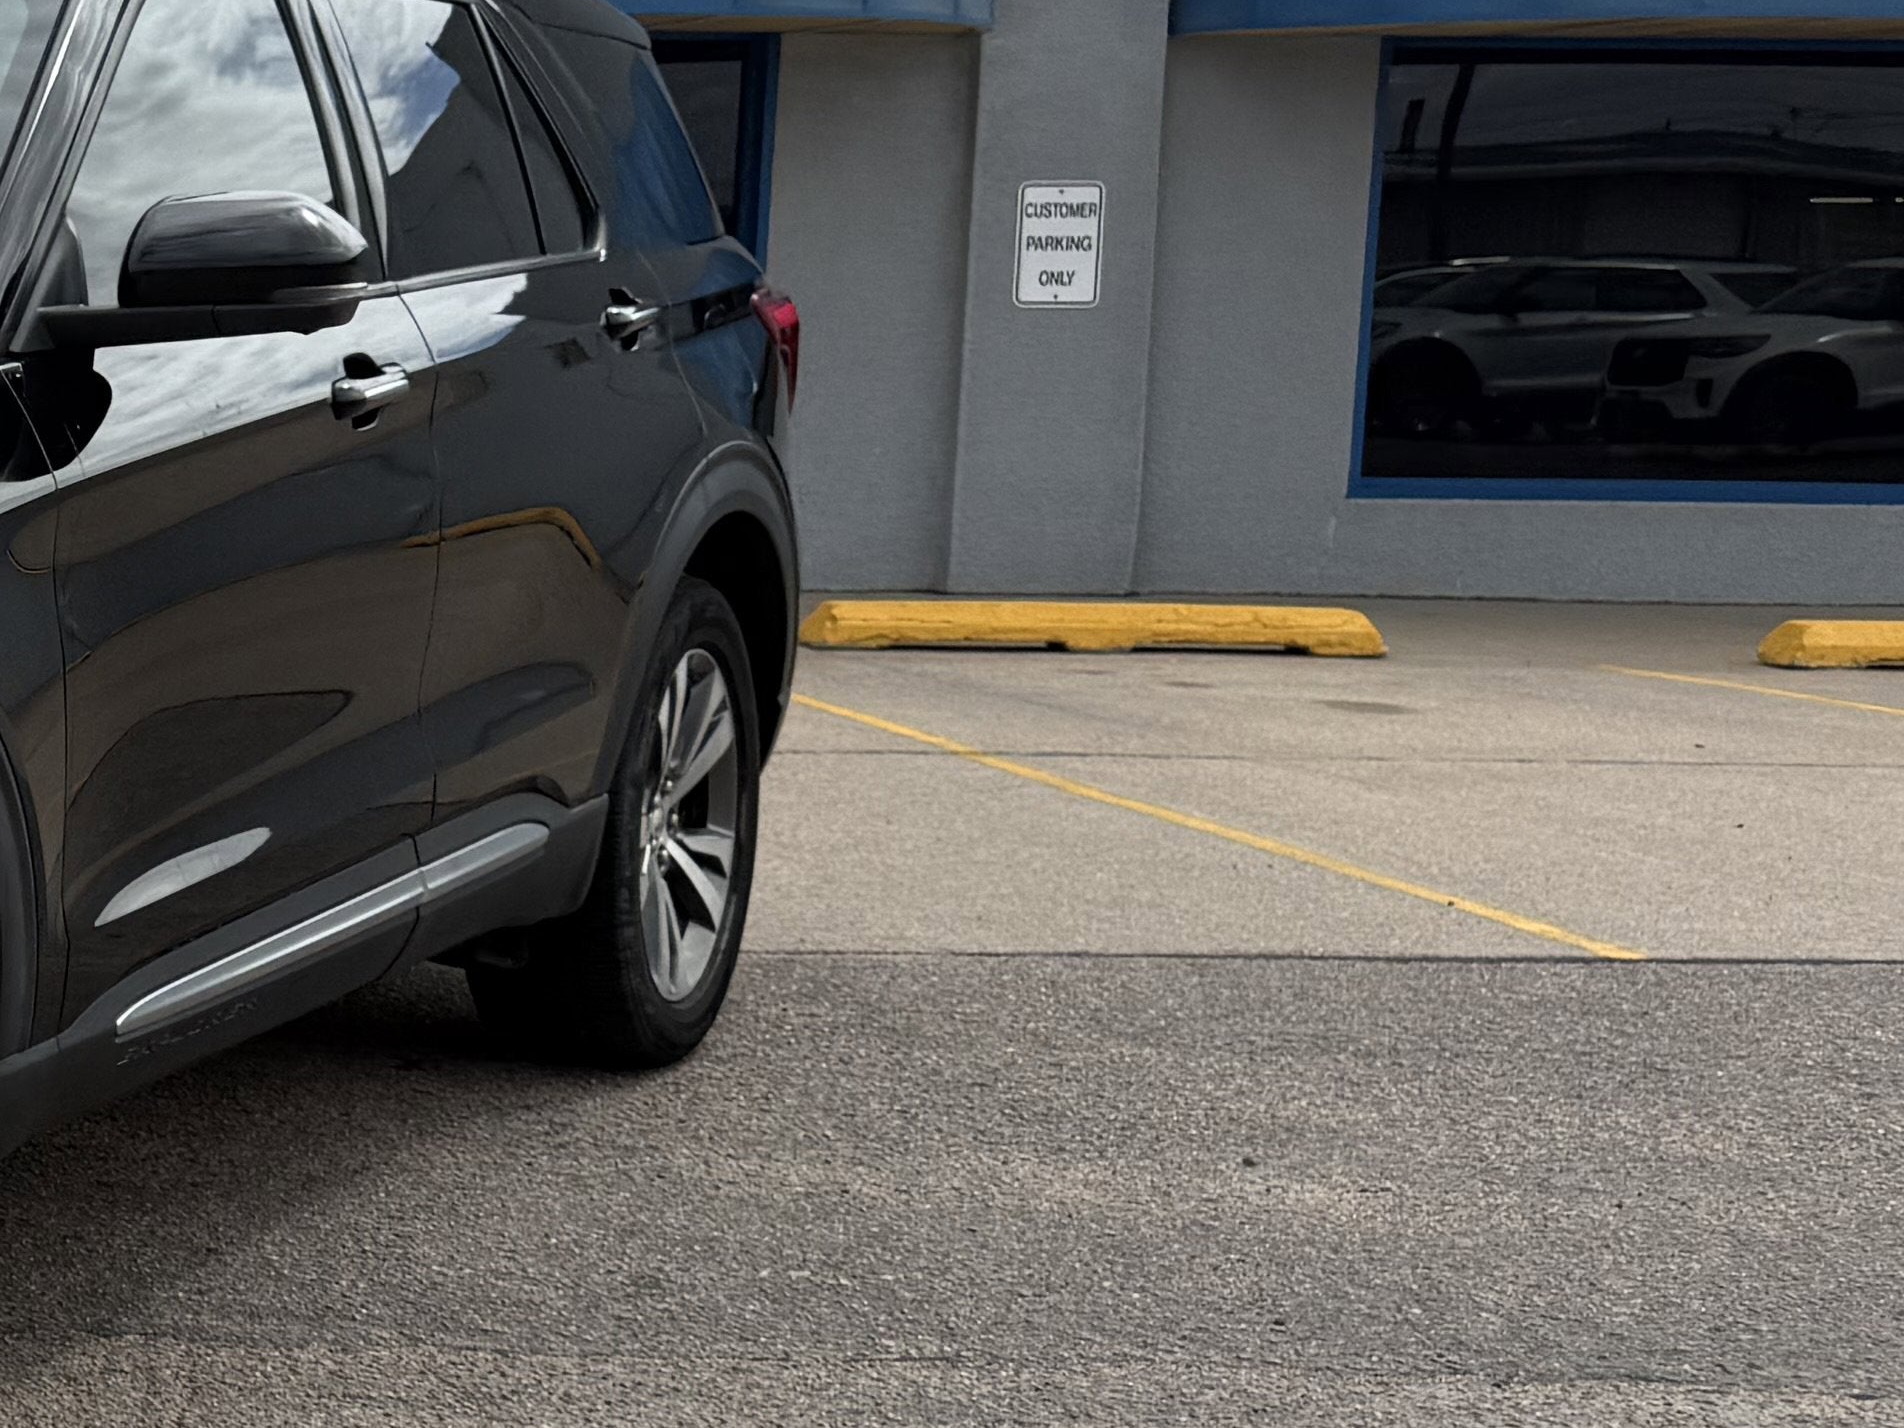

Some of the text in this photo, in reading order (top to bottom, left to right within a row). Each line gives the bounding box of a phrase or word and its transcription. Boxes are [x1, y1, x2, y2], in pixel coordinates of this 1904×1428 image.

[1024, 201, 1098, 219] CUSTOMER
[1026, 235, 1093, 252] PARKING
[1038, 269, 1075, 287] ONLY
